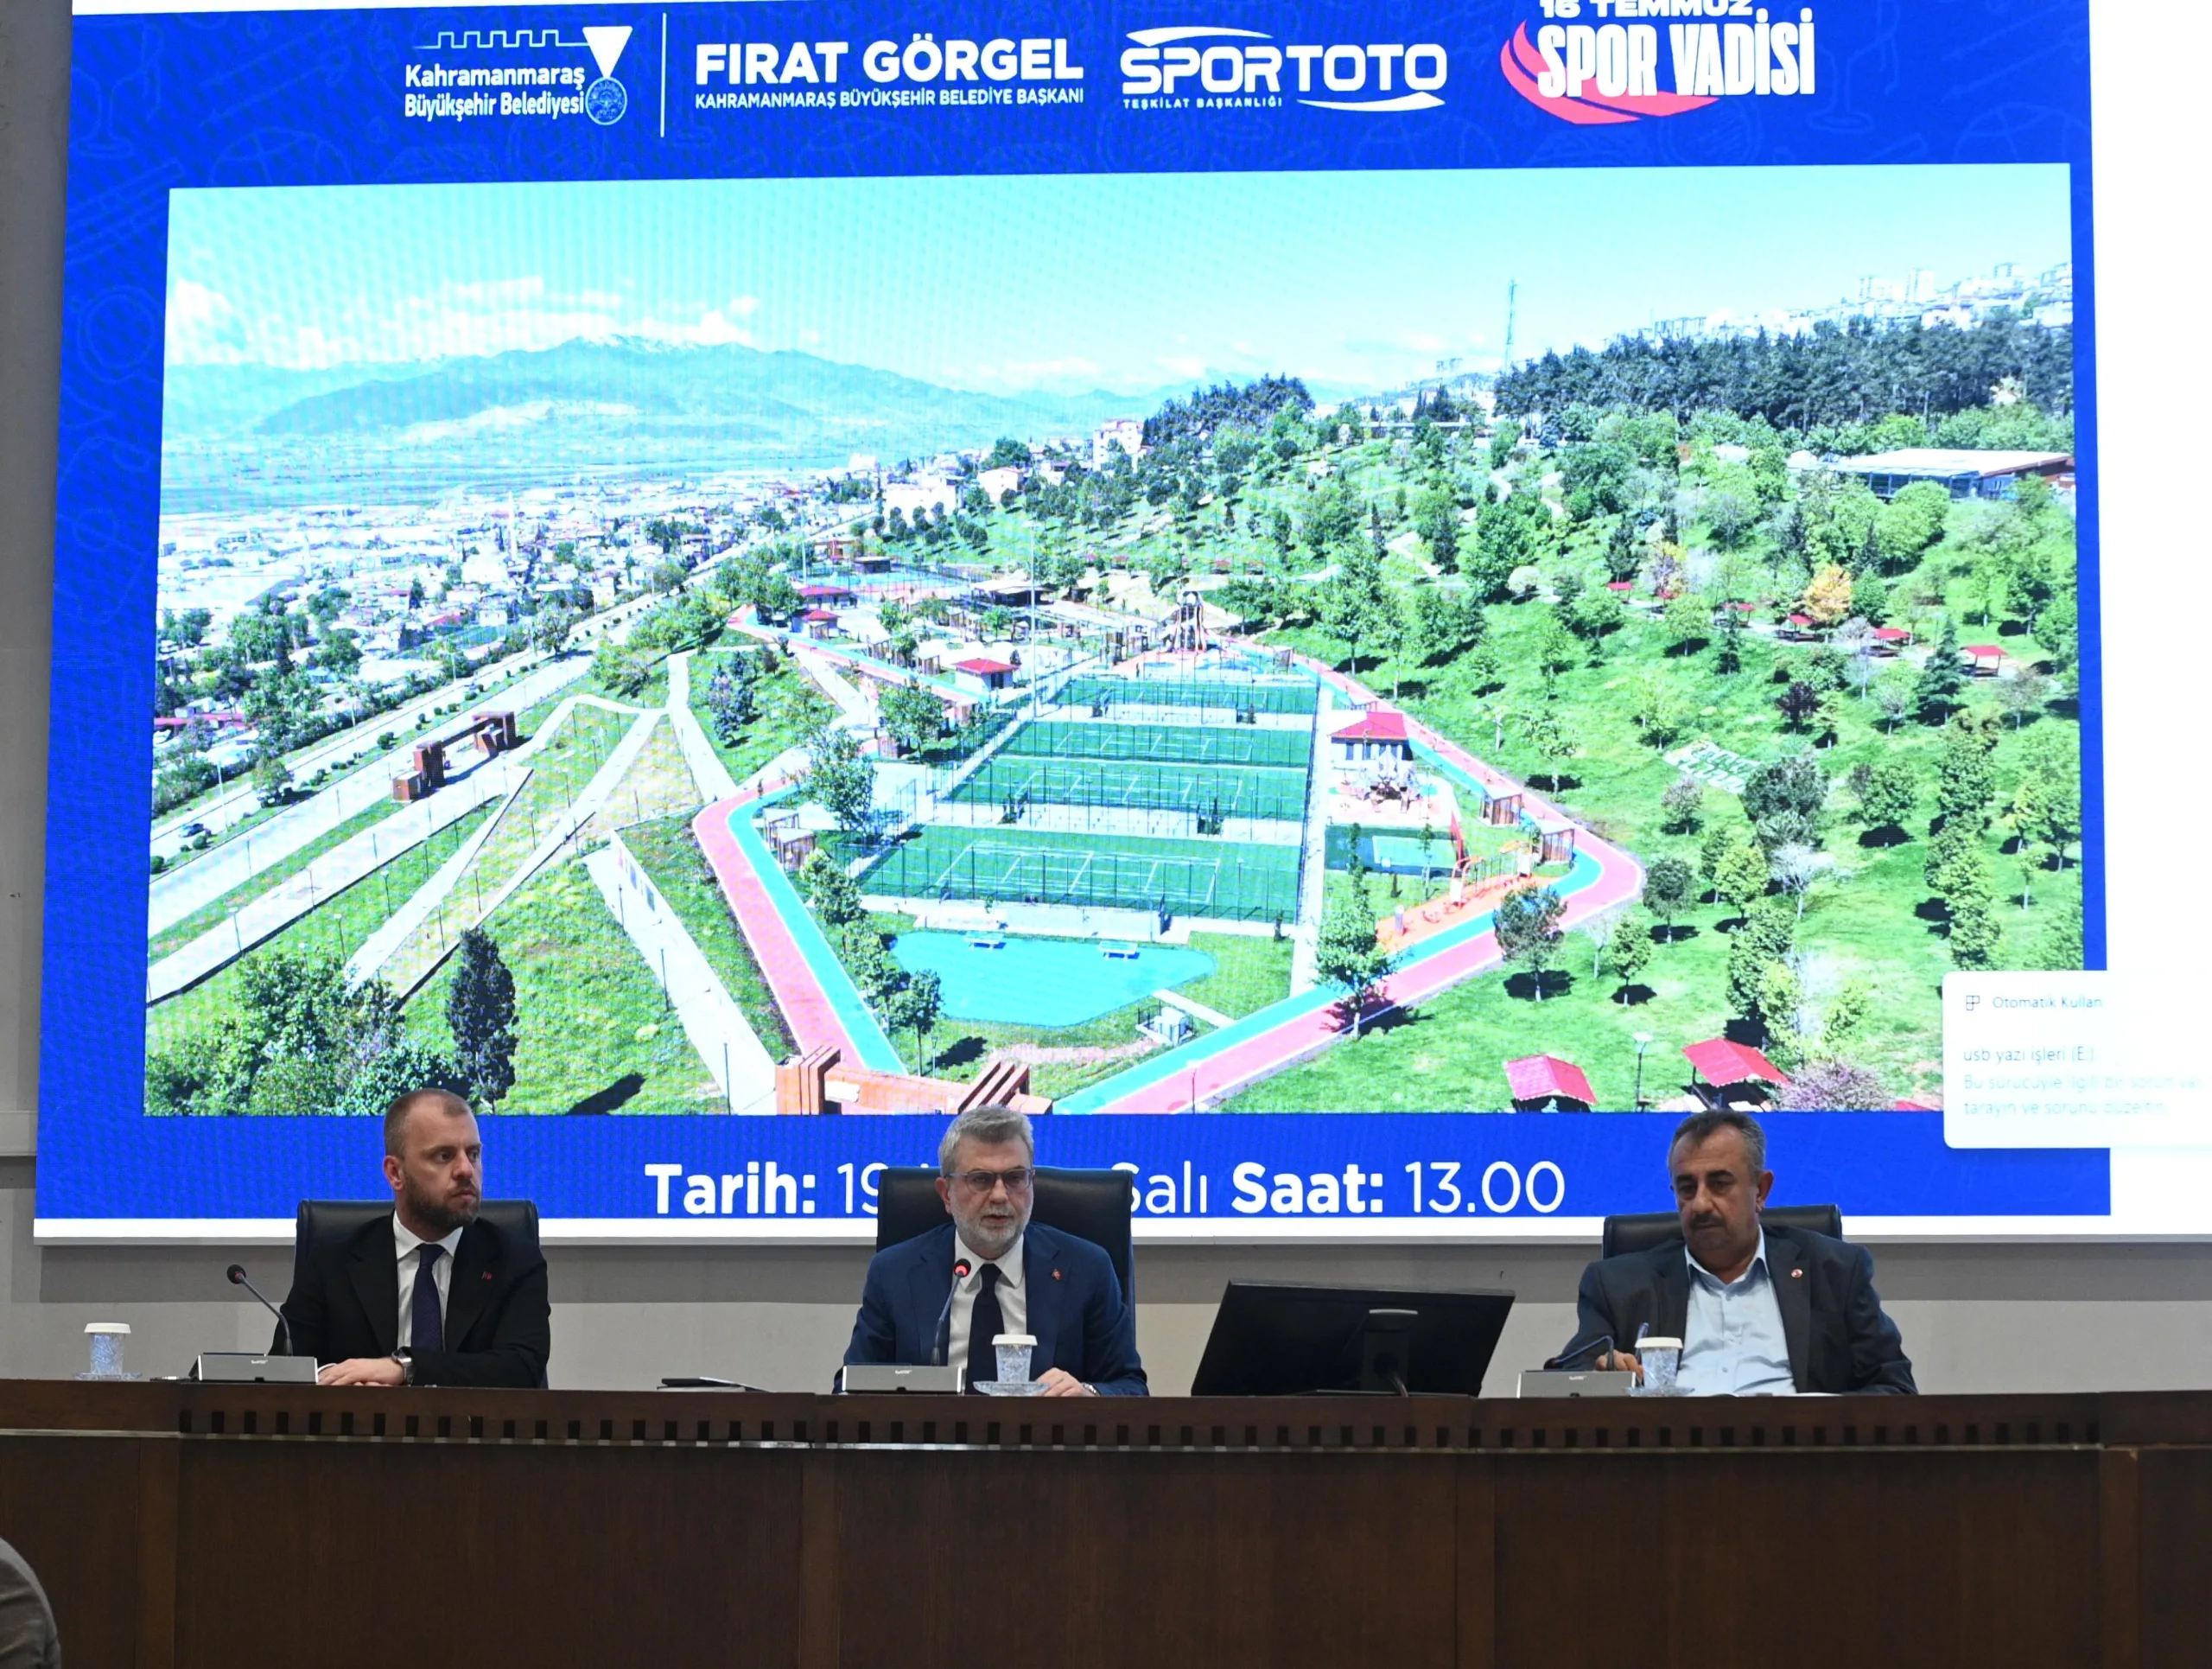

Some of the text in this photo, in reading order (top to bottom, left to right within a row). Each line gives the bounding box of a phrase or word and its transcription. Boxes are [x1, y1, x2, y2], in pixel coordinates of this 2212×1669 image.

[1590, 0, 1752, 17] TEMMUZ
[696, 33, 1084, 85] FIRAT GÖRGEL
[1537, 8, 1815, 98] SPOR VADİSİ
[405, 63, 586, 90] Kahramanmaraş
[404, 91, 584, 122] Büyükşehir Belediyesi
[695, 87, 1084, 110] KAHRAMANMARAŞ BÜYÜKŞEHİR BELEDİYE BAŞKANI
[1122, 95, 1283, 110] TEŞKİLAT BAŞKANLIĞI
[1993, 996, 2056, 1009] Otomatik
[1963, 1048, 1991, 1062] usb
[645, 1161, 816, 1215] Tarih:
[1231, 1162, 1383, 1215] Saat:
[1405, 1162, 1565, 1214] 13.00
